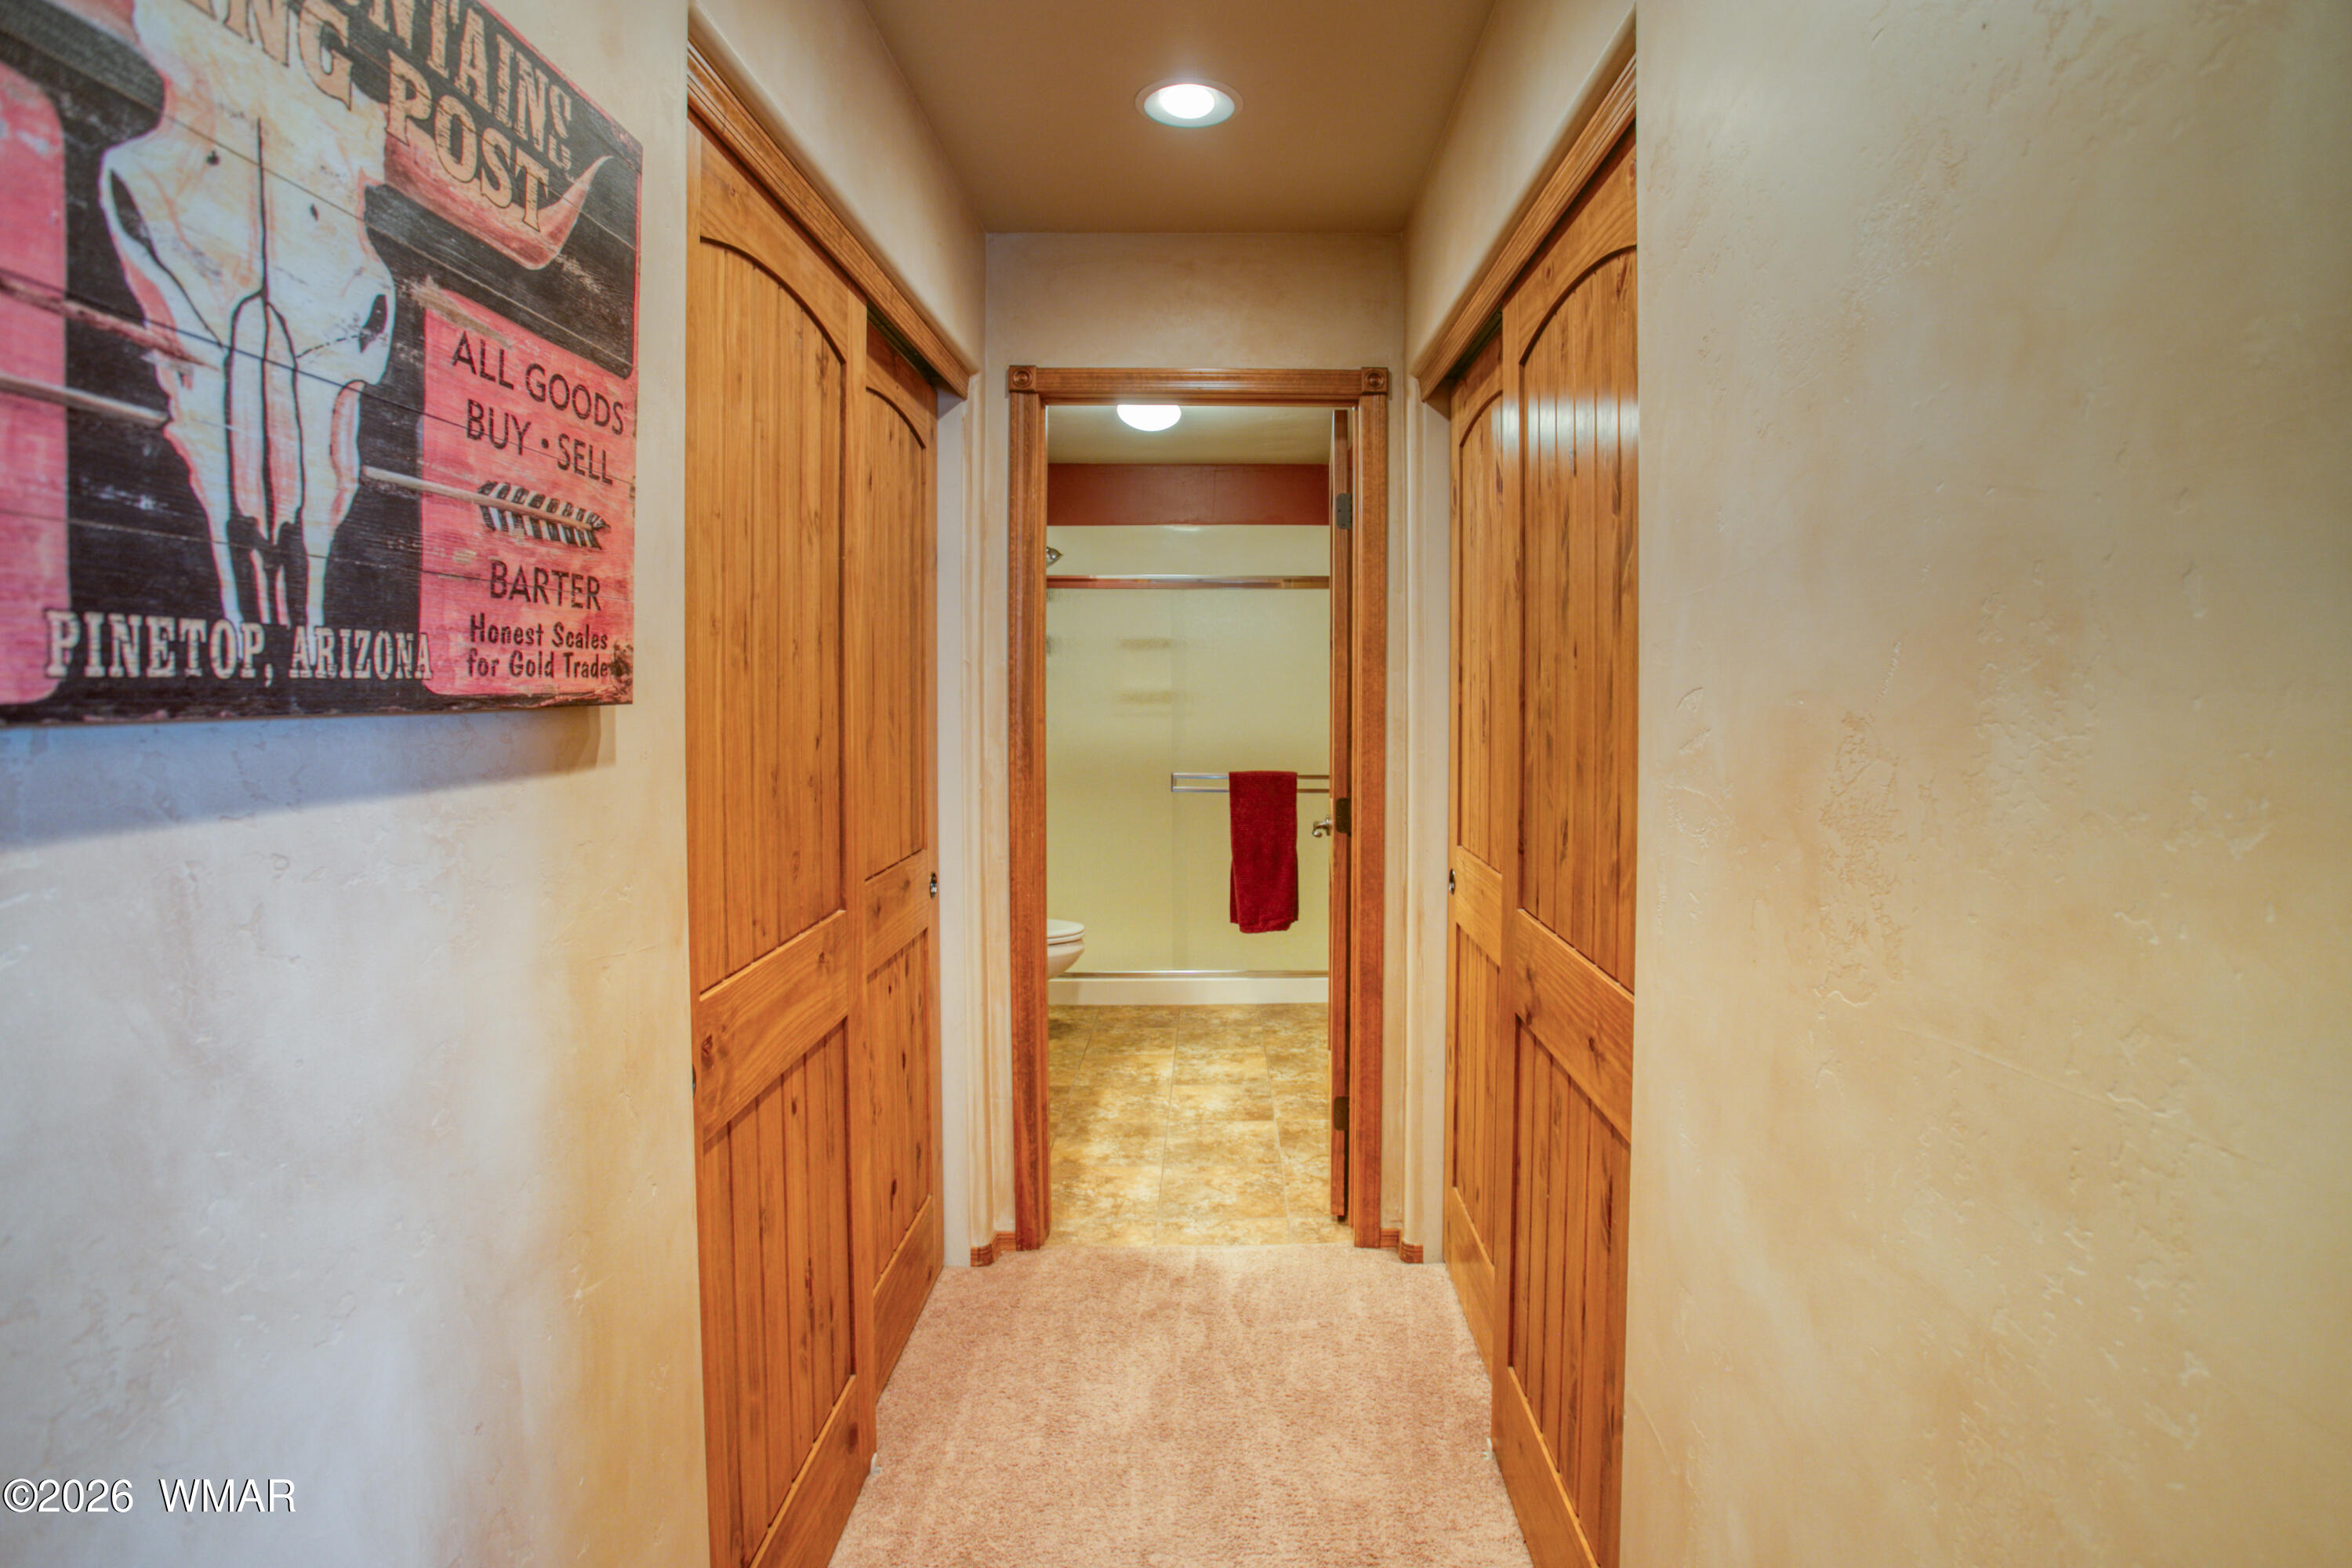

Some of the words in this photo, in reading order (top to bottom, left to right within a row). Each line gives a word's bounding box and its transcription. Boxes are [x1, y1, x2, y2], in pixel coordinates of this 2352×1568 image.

[385, 48, 550, 233] POST
[452, 330, 514, 390] ALL
[525, 363, 624, 435] GOODS
[466, 398, 532, 456] BUY
[557, 433, 613, 486] SELL
[490, 559, 601, 611] BARTER
[45, 608, 274, 688] PINETOP,
[289, 625, 433, 681] ARIZONA
[466, 648, 499, 677] for
[510, 649, 554, 679] Gold
[563, 652, 609, 679] Trade
[470, 612, 544, 647] Honest
[552, 621, 608, 650] Scales
